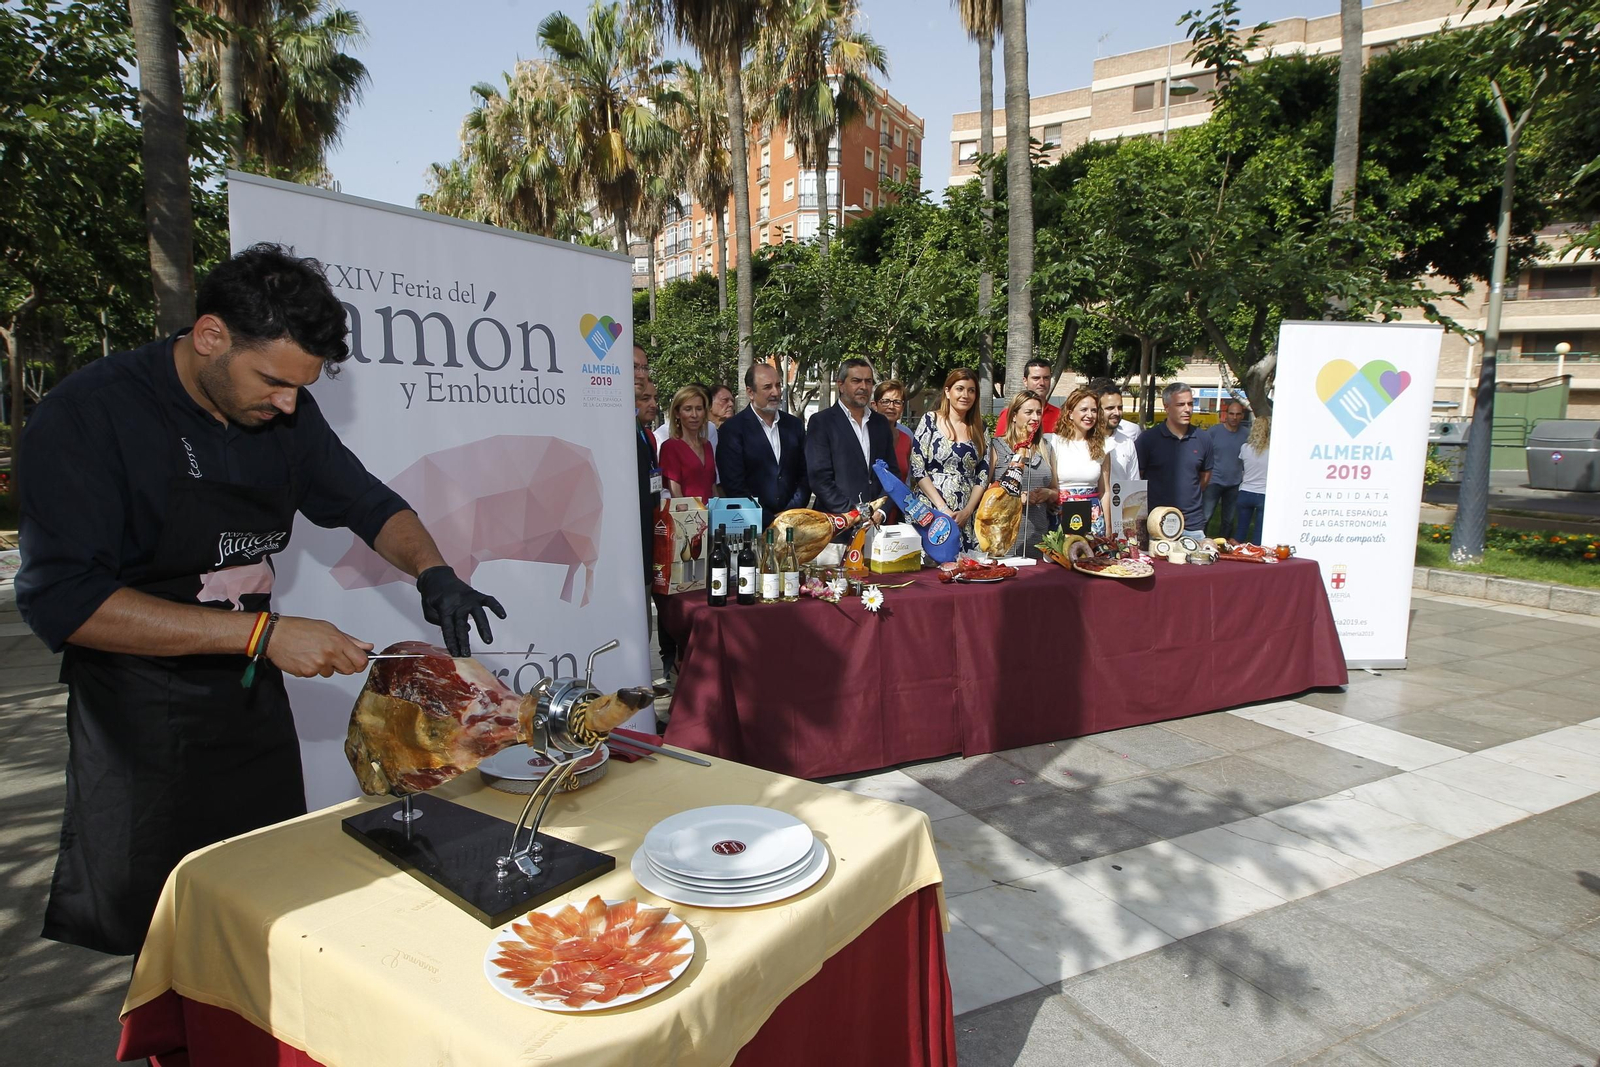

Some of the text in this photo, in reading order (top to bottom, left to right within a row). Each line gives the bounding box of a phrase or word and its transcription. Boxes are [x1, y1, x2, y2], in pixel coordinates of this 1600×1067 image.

[391, 272, 443, 301] Feria
[448, 281, 477, 305] del
[340, 290, 564, 375] amón
[582, 363, 621, 375] ALMERÍA
[590, 376, 612, 386] 2019
[399, 371, 566, 409] y Embutidos
[1309, 441, 1394, 461] ALMERÍA
[1325, 464, 1372, 480] 2019
[1305, 491, 1389, 500] CANDIDATA
[1303, 508, 1388, 518] A CAPITAL ESPAÑOLA
[1302, 519, 1387, 528] DE LA GASTRONOMÍA
[1299, 532, 1387, 546] El gusto de compartir
[491, 643, 578, 697] rón
